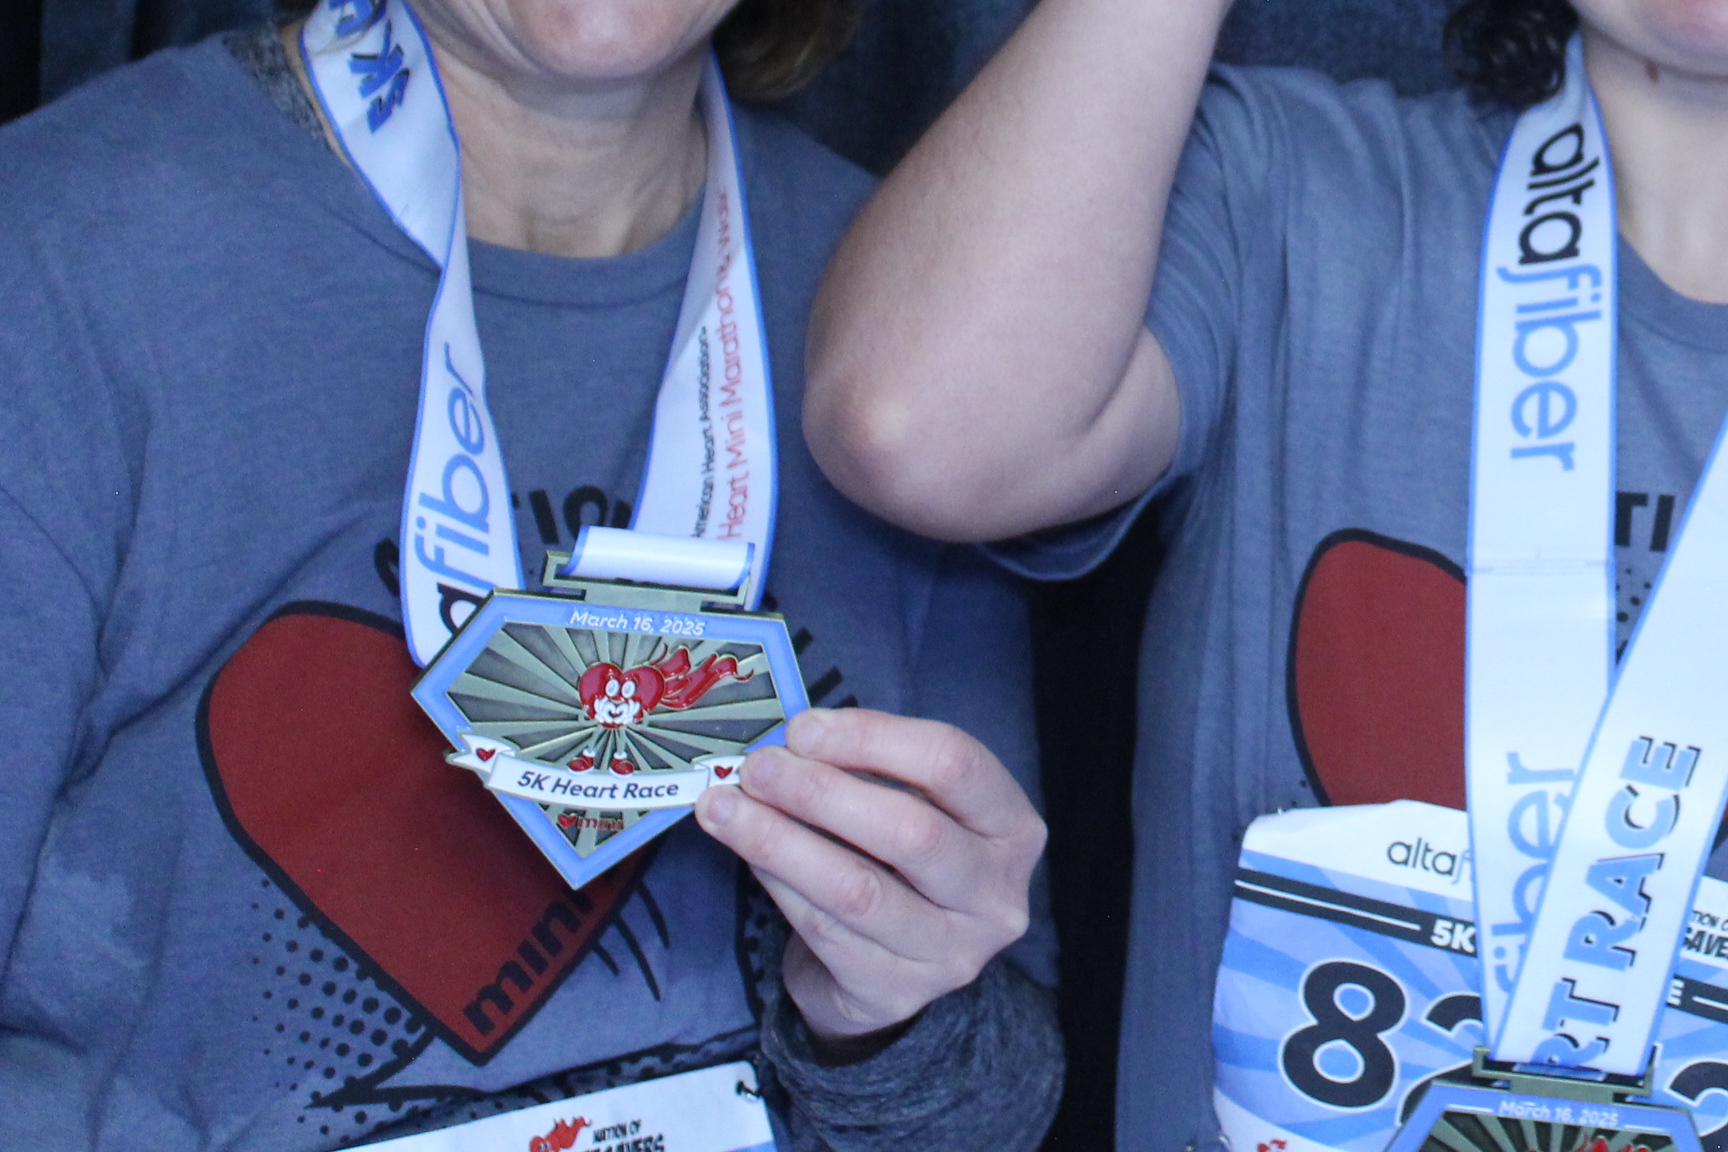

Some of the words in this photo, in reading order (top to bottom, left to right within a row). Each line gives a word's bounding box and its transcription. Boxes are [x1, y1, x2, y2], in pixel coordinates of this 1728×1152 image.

[1496, 123, 1603, 471] altafiber
[715, 276, 744, 409] Marathon
[700, 423, 715, 475] Heart
[721, 410, 749, 470] Mini
[716, 470, 750, 540] Heart
[570, 610, 627, 631] March
[660, 619, 706, 636] 2025
[517, 770, 550, 791] 5K
[551, 777, 617, 798] Heart
[624, 782, 679, 799] Race
[1563, 735, 1701, 972] RACE
[1430, 918, 1476, 954] 5K
[1499, 1100, 1550, 1120] March
